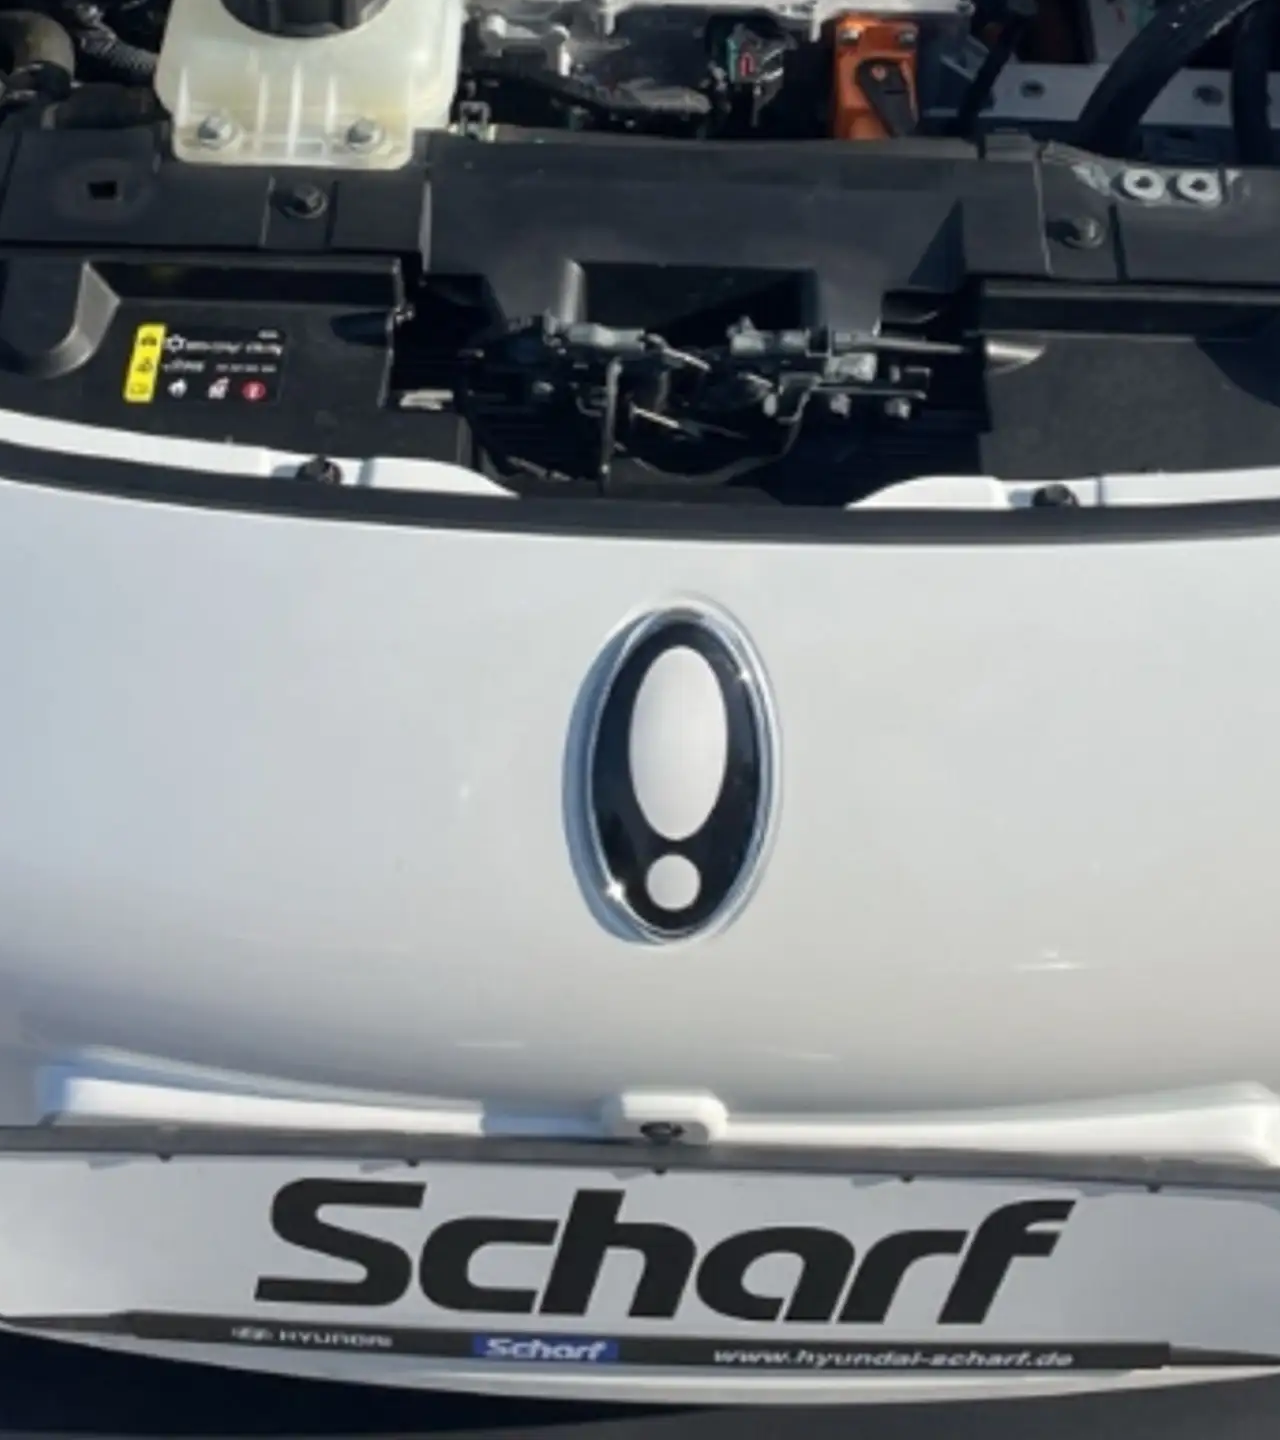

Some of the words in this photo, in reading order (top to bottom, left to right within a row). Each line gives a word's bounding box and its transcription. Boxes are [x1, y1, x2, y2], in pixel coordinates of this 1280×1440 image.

[254, 1177, 1077, 1326] Scharf
[484, 1337, 607, 1361] Scharf
[713, 1348, 1074, 1369] www.hyundai-scharf.de
